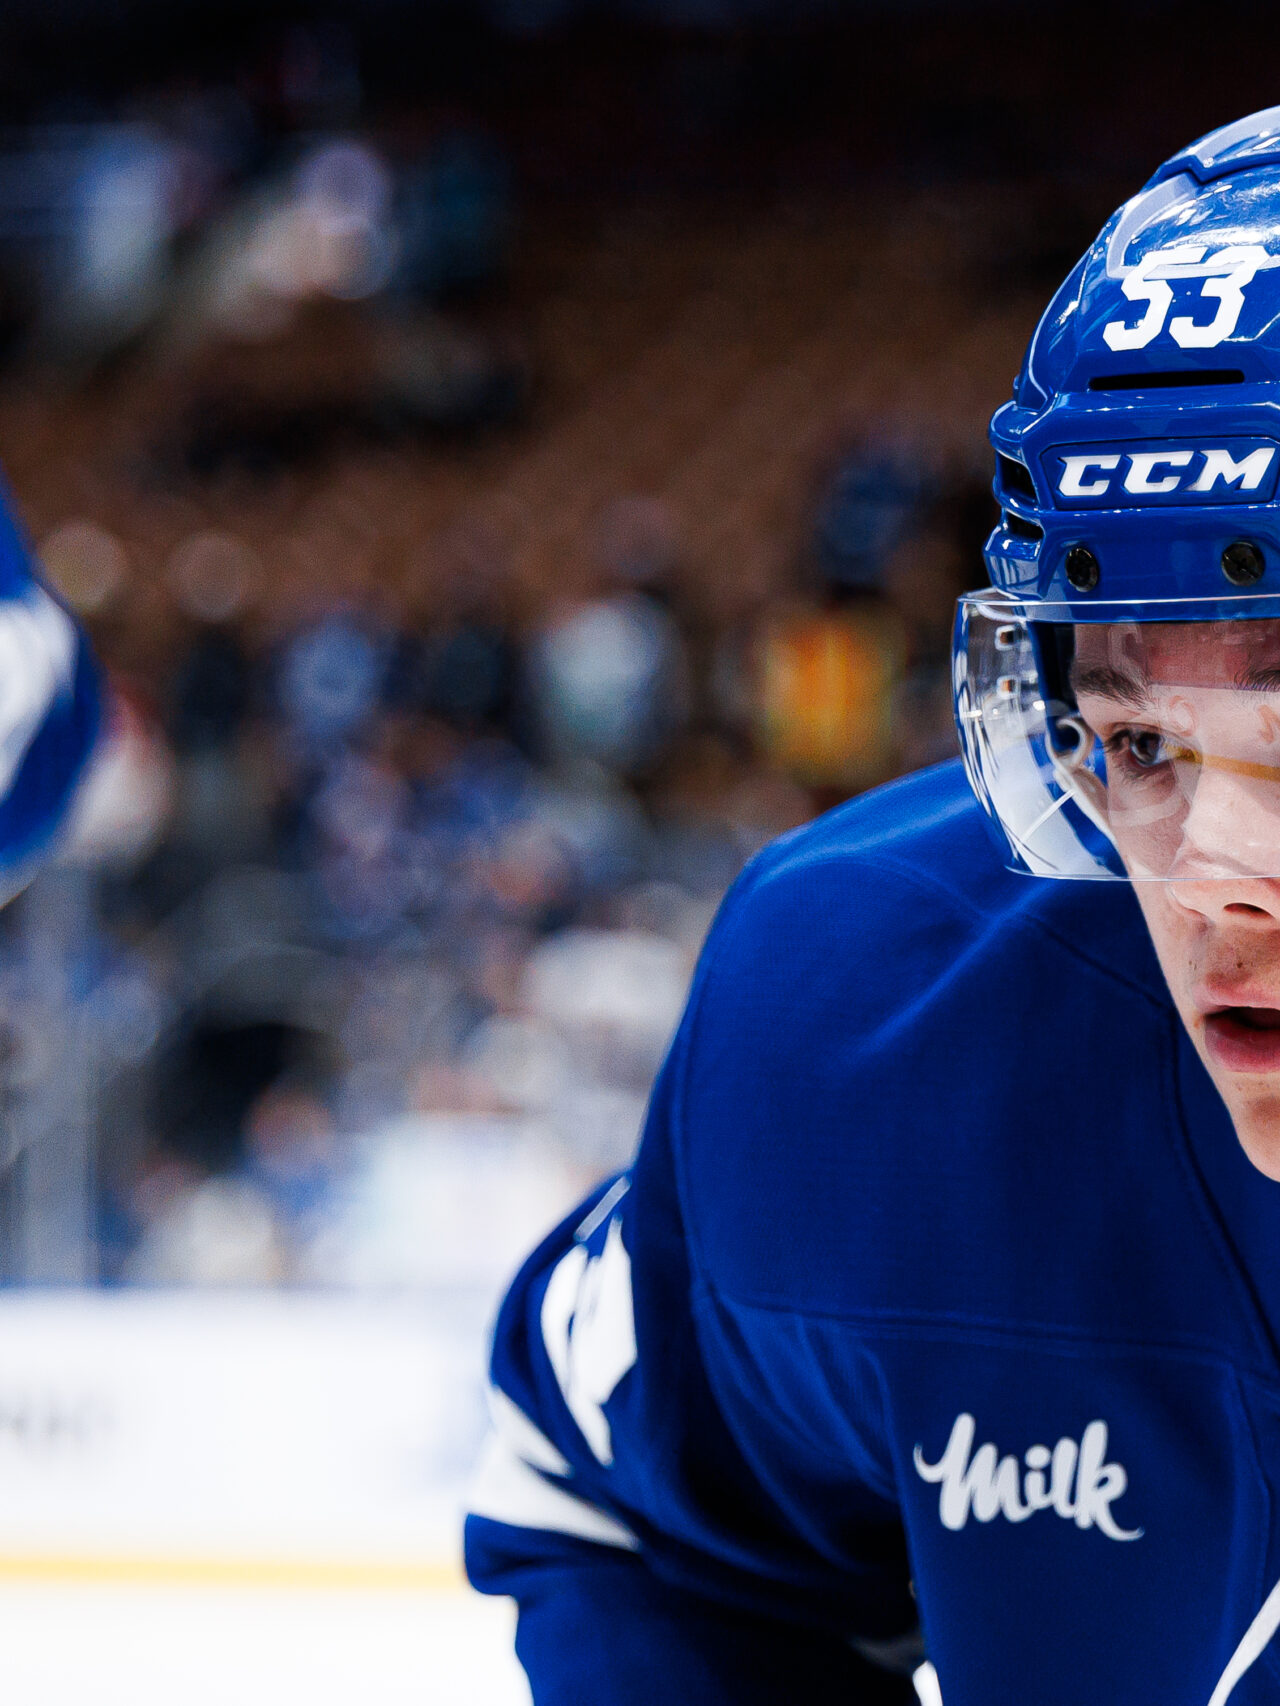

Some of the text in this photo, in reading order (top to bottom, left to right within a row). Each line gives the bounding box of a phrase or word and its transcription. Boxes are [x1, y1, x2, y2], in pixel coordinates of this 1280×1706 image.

[1103, 245, 1269, 351] 53
[1057, 448, 1276, 496] CCM
[913, 1412, 1145, 1542] Milk
